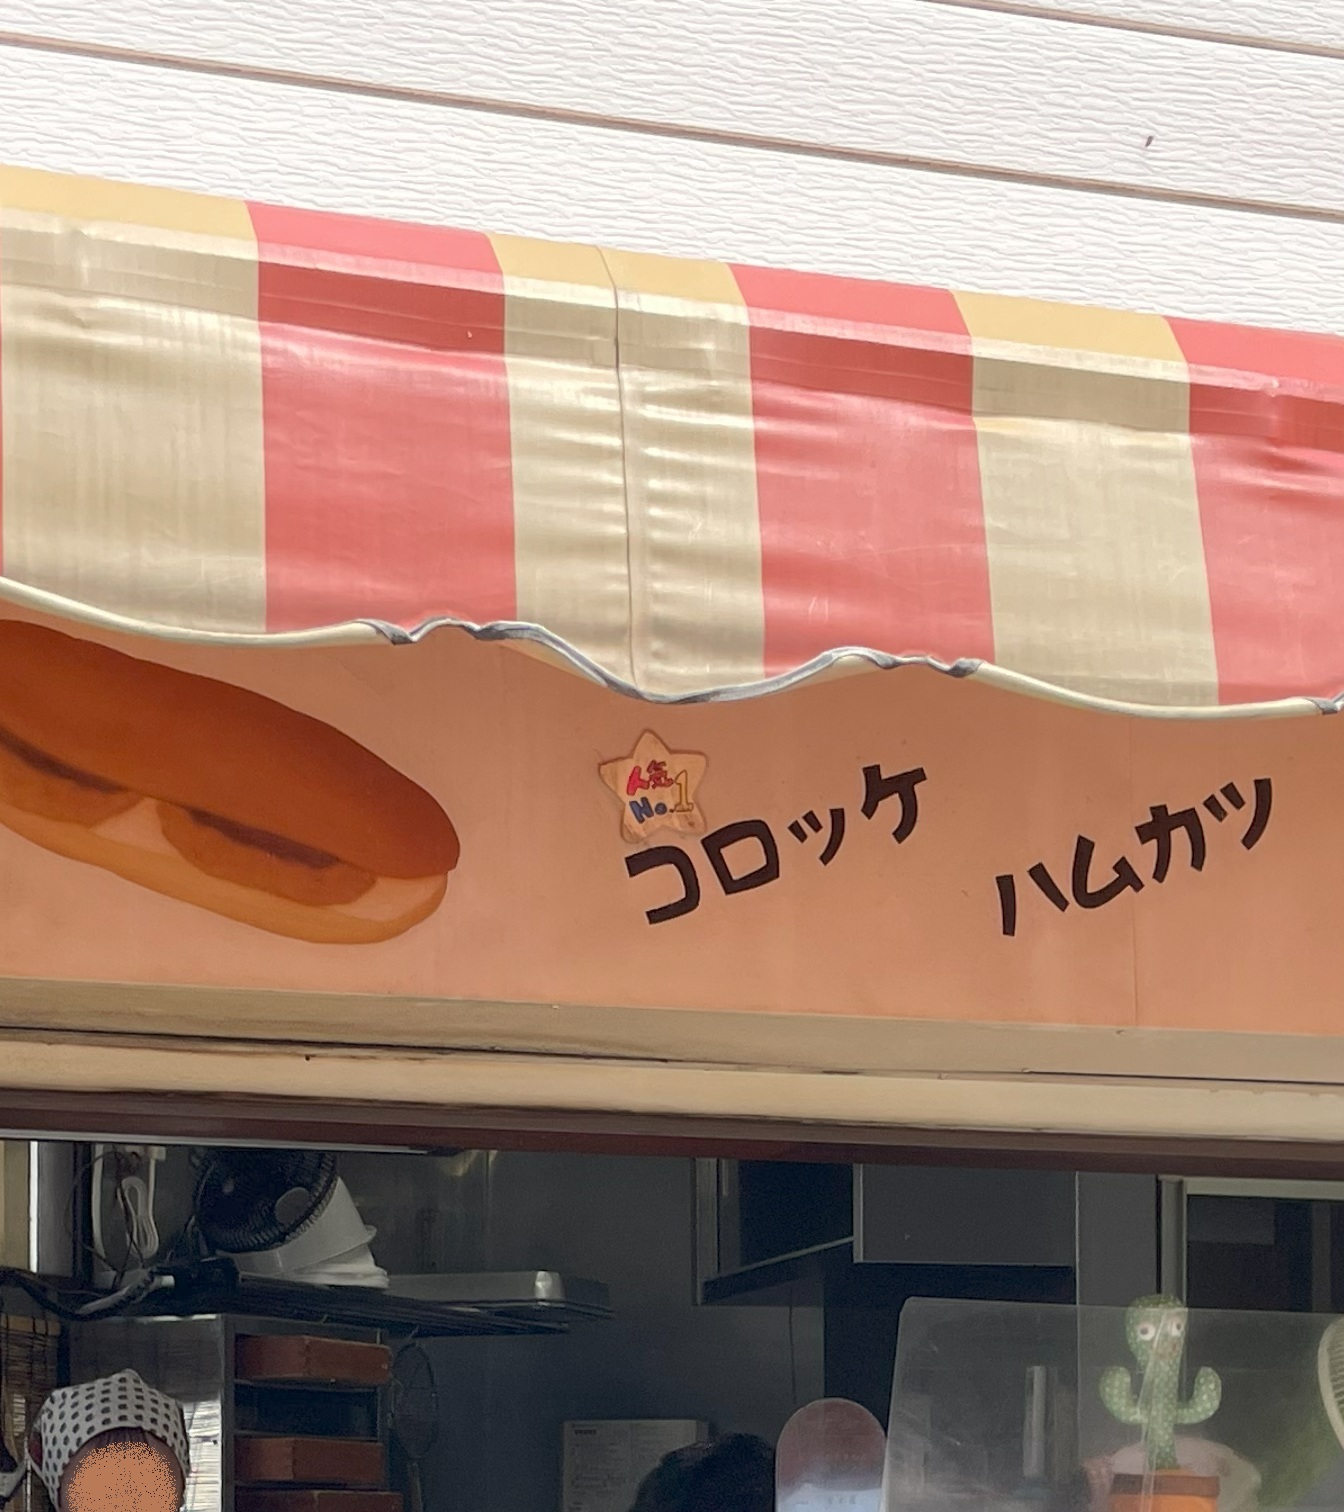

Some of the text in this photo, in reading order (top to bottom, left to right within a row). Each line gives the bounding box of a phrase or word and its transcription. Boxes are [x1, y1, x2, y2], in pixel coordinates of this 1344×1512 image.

[624, 764, 928, 925] コロッケ
[995, 778, 1273, 937] ハムカツ
